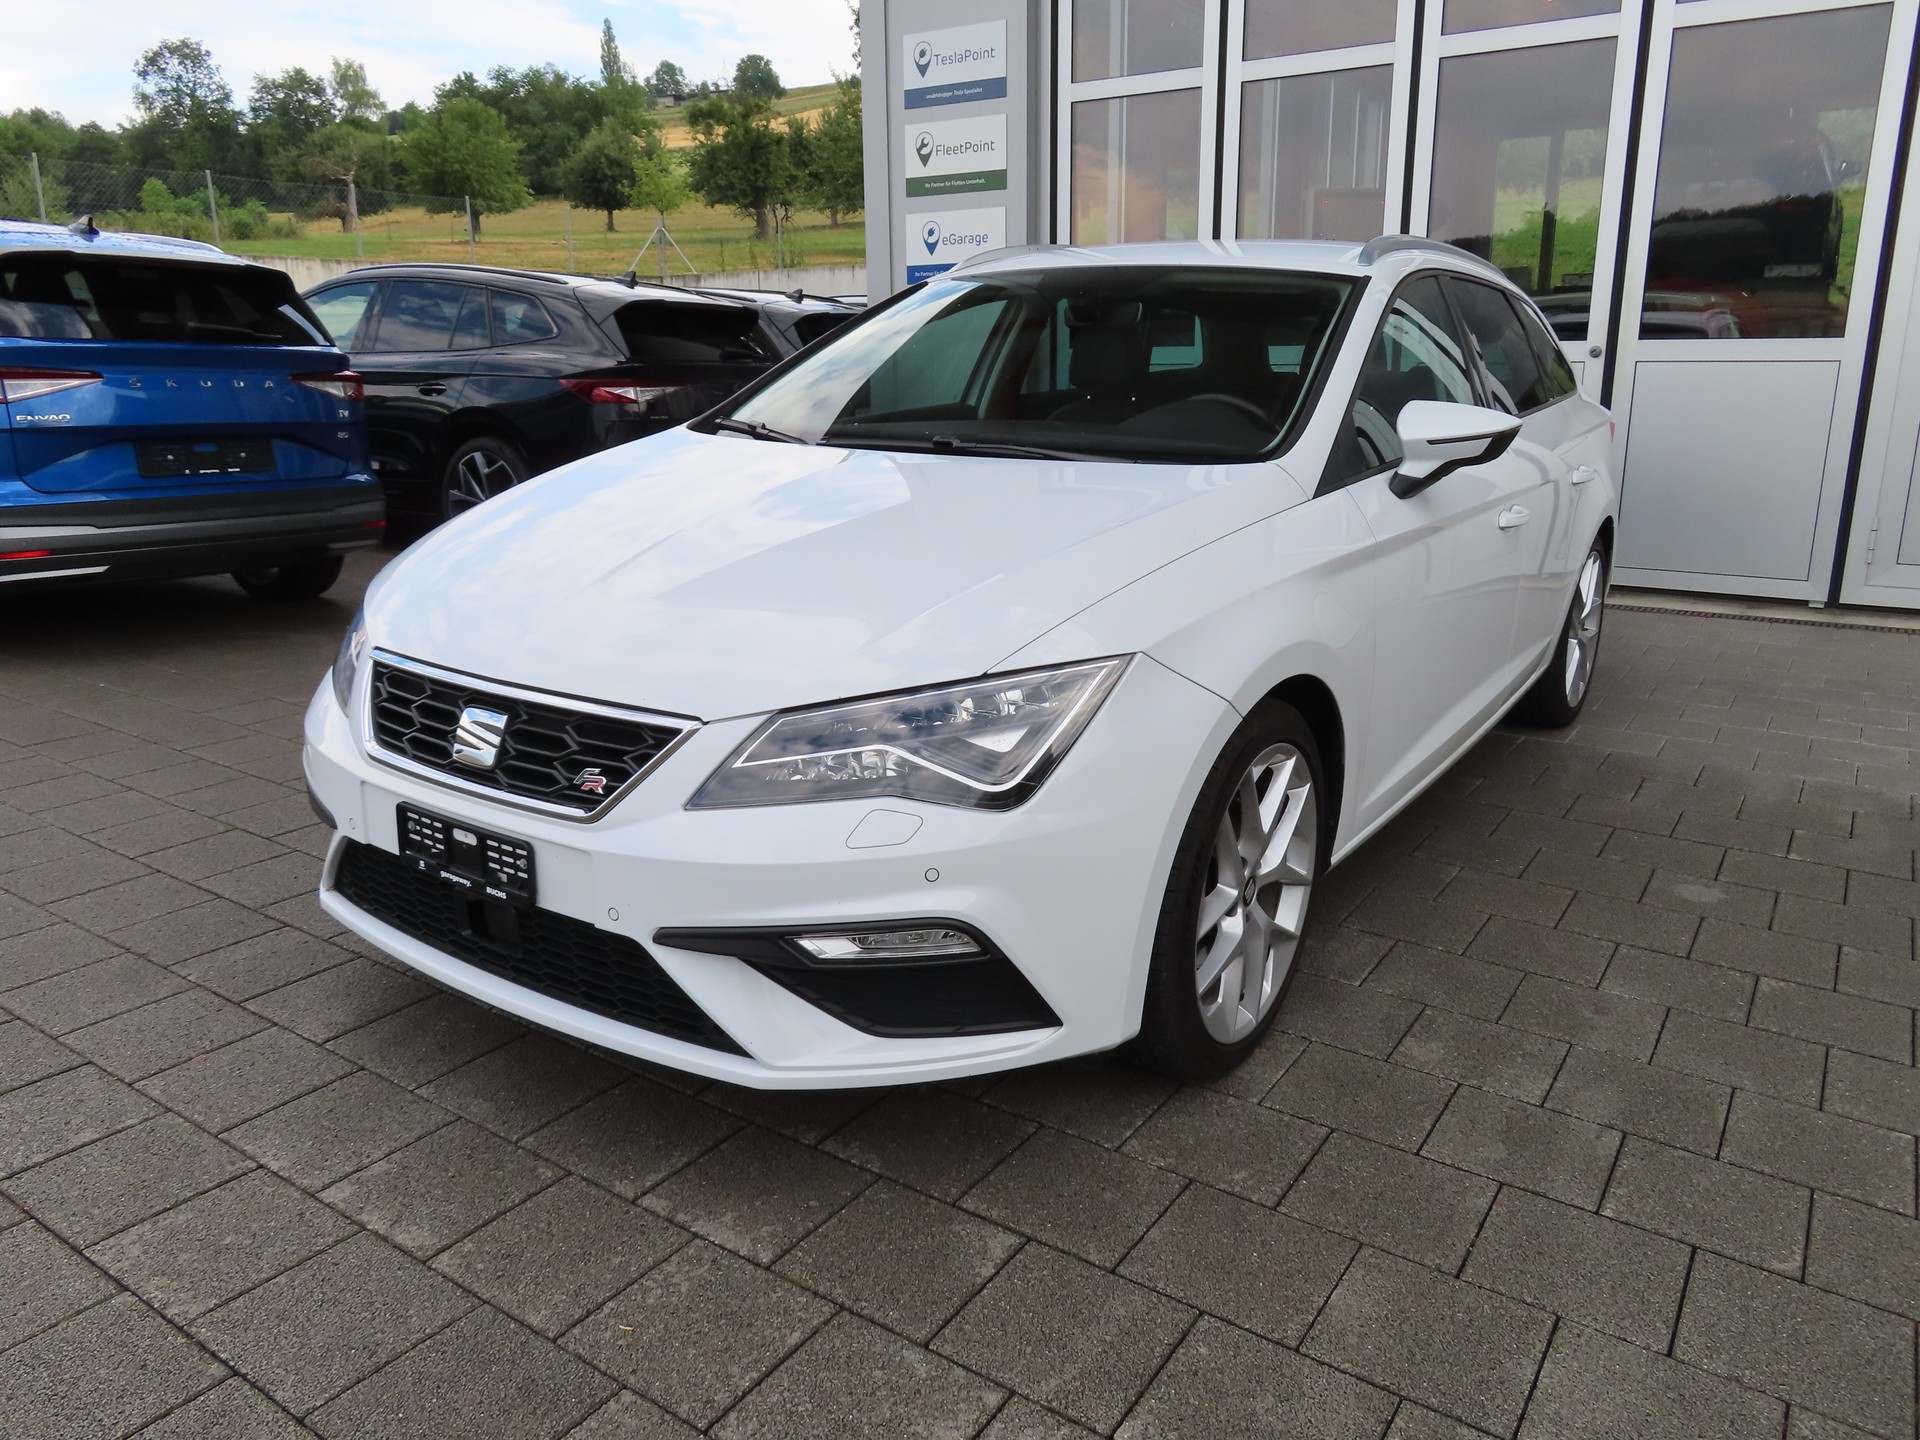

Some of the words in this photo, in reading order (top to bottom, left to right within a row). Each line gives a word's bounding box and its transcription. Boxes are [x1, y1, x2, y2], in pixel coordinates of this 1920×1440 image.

[933, 47, 996, 66] TeslaPoint
[935, 140, 996, 157] FleetPoint
[942, 233, 989, 246] eGarage
[573, 767, 607, 795] FR
[486, 886, 507, 899] BUCHS
